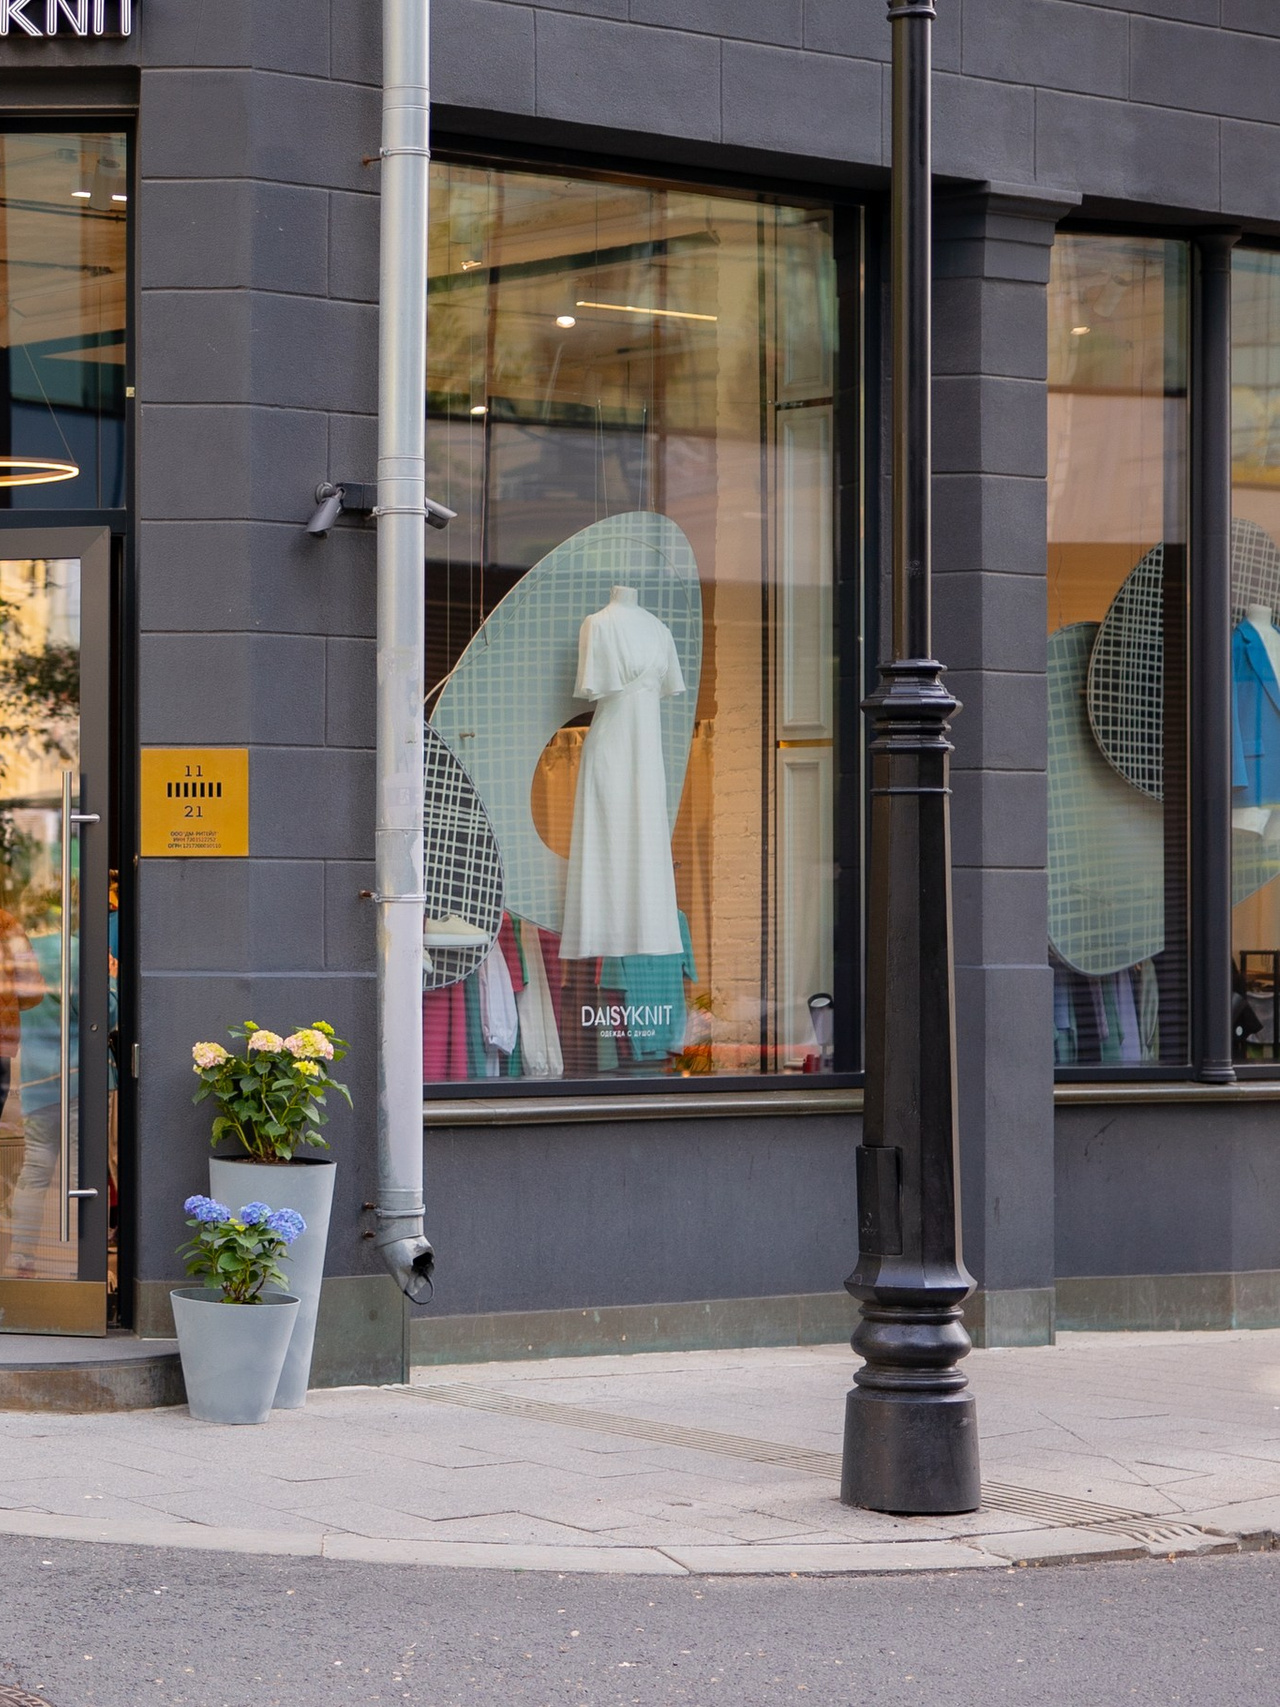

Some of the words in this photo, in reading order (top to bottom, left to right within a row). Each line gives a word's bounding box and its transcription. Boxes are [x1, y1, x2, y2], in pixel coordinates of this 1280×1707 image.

[184, 765, 204, 777] 11
[184, 805, 204, 818] 21
[581, 1005, 673, 1027] DAISYKNIT
[600, 1030, 626, 1038] ОДЕЖДА
[634, 1029, 656, 1038] ДУШОЙ
